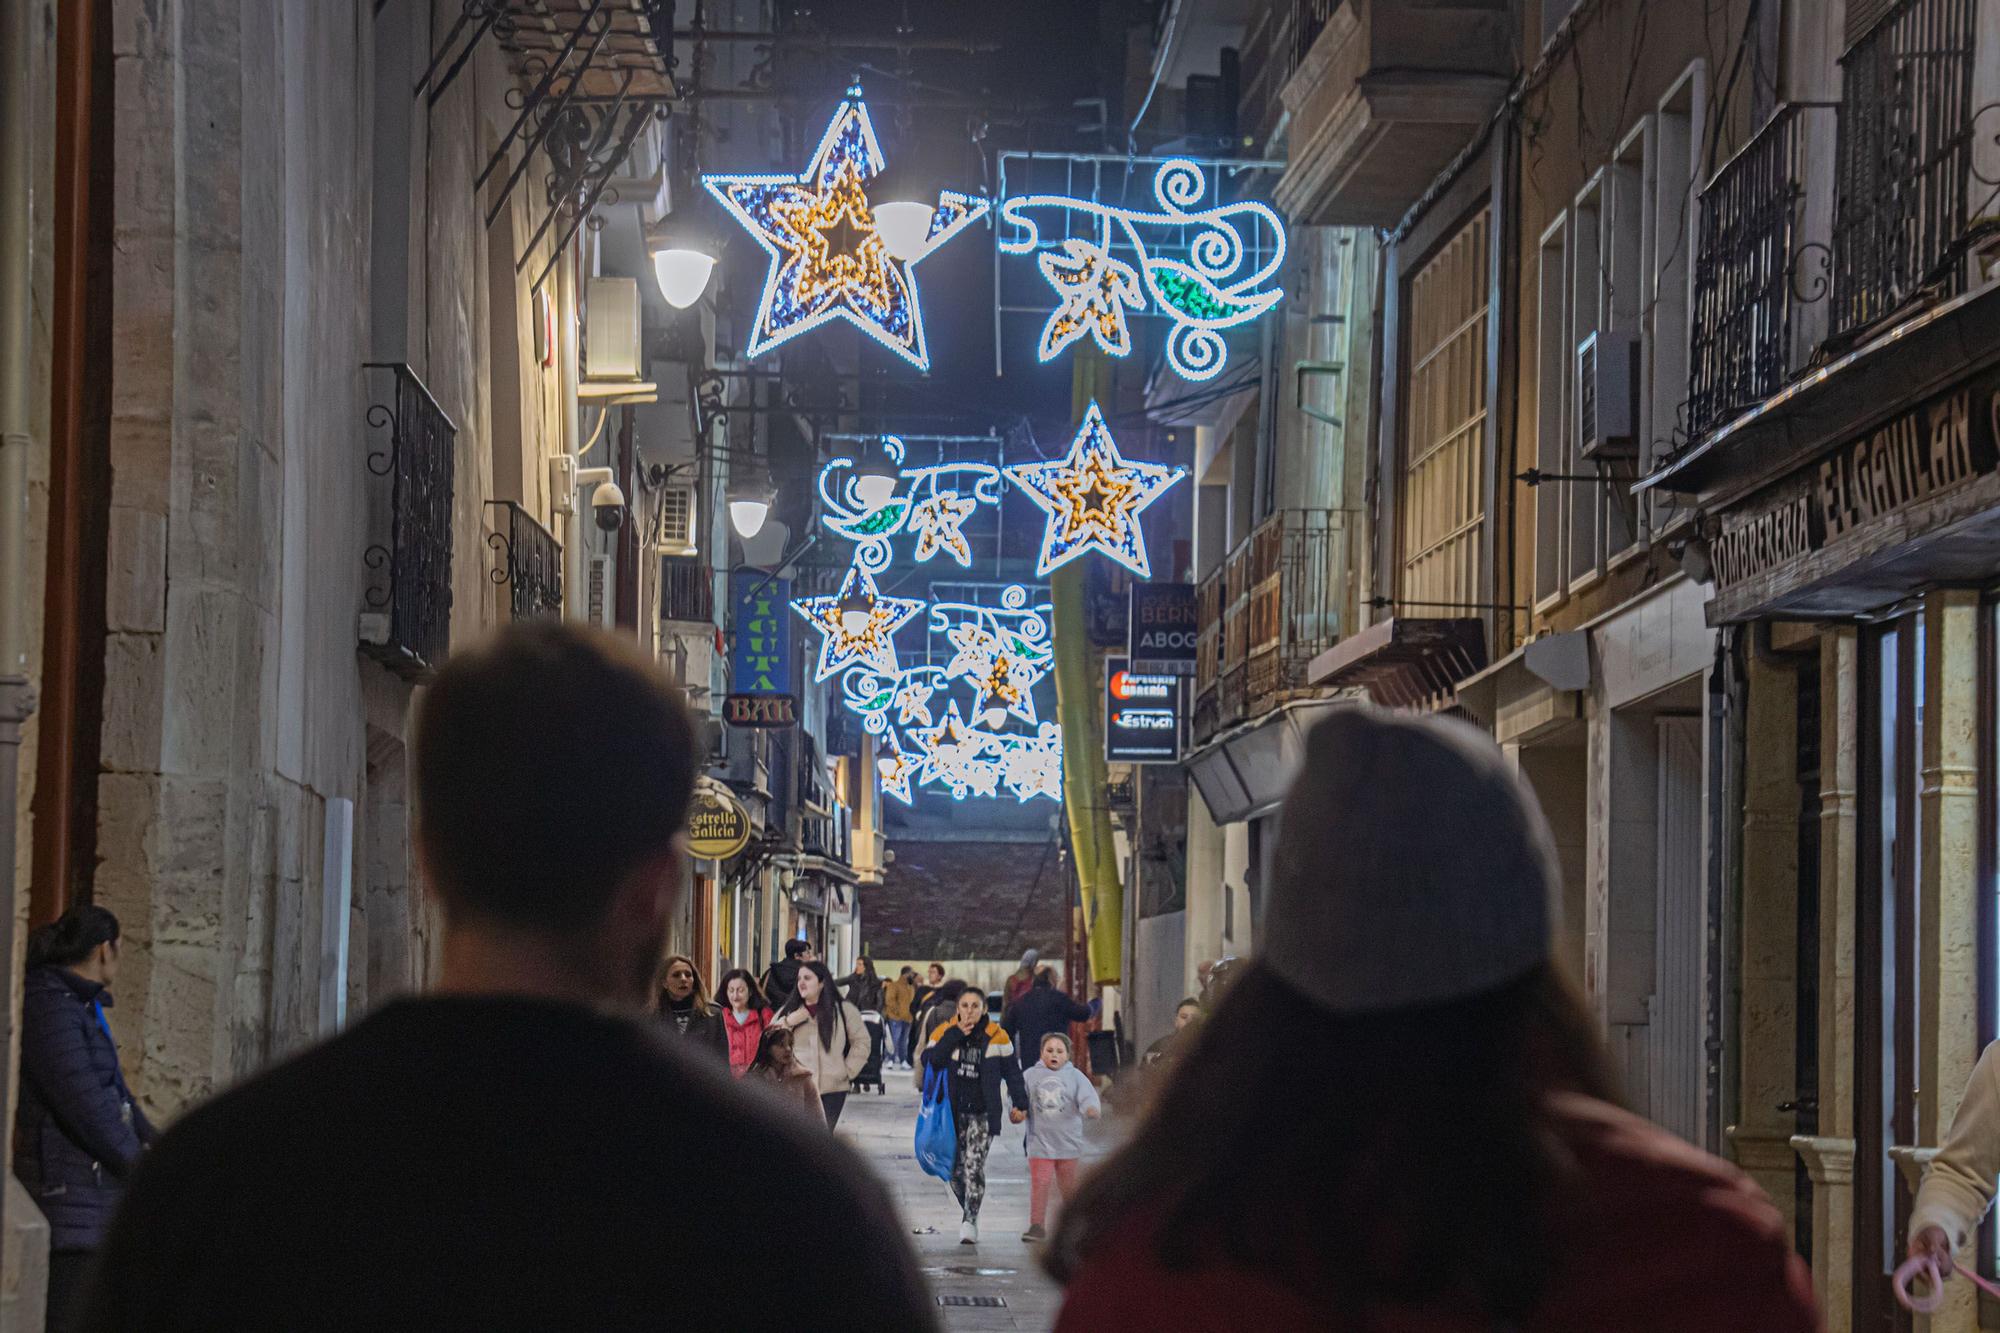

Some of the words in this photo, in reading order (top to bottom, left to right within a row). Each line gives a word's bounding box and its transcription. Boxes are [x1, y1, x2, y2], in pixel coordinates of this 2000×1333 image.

[1819, 453, 1852, 547] EL
[729, 698, 796, 722] BAR
[689, 824, 735, 838] Galicia
